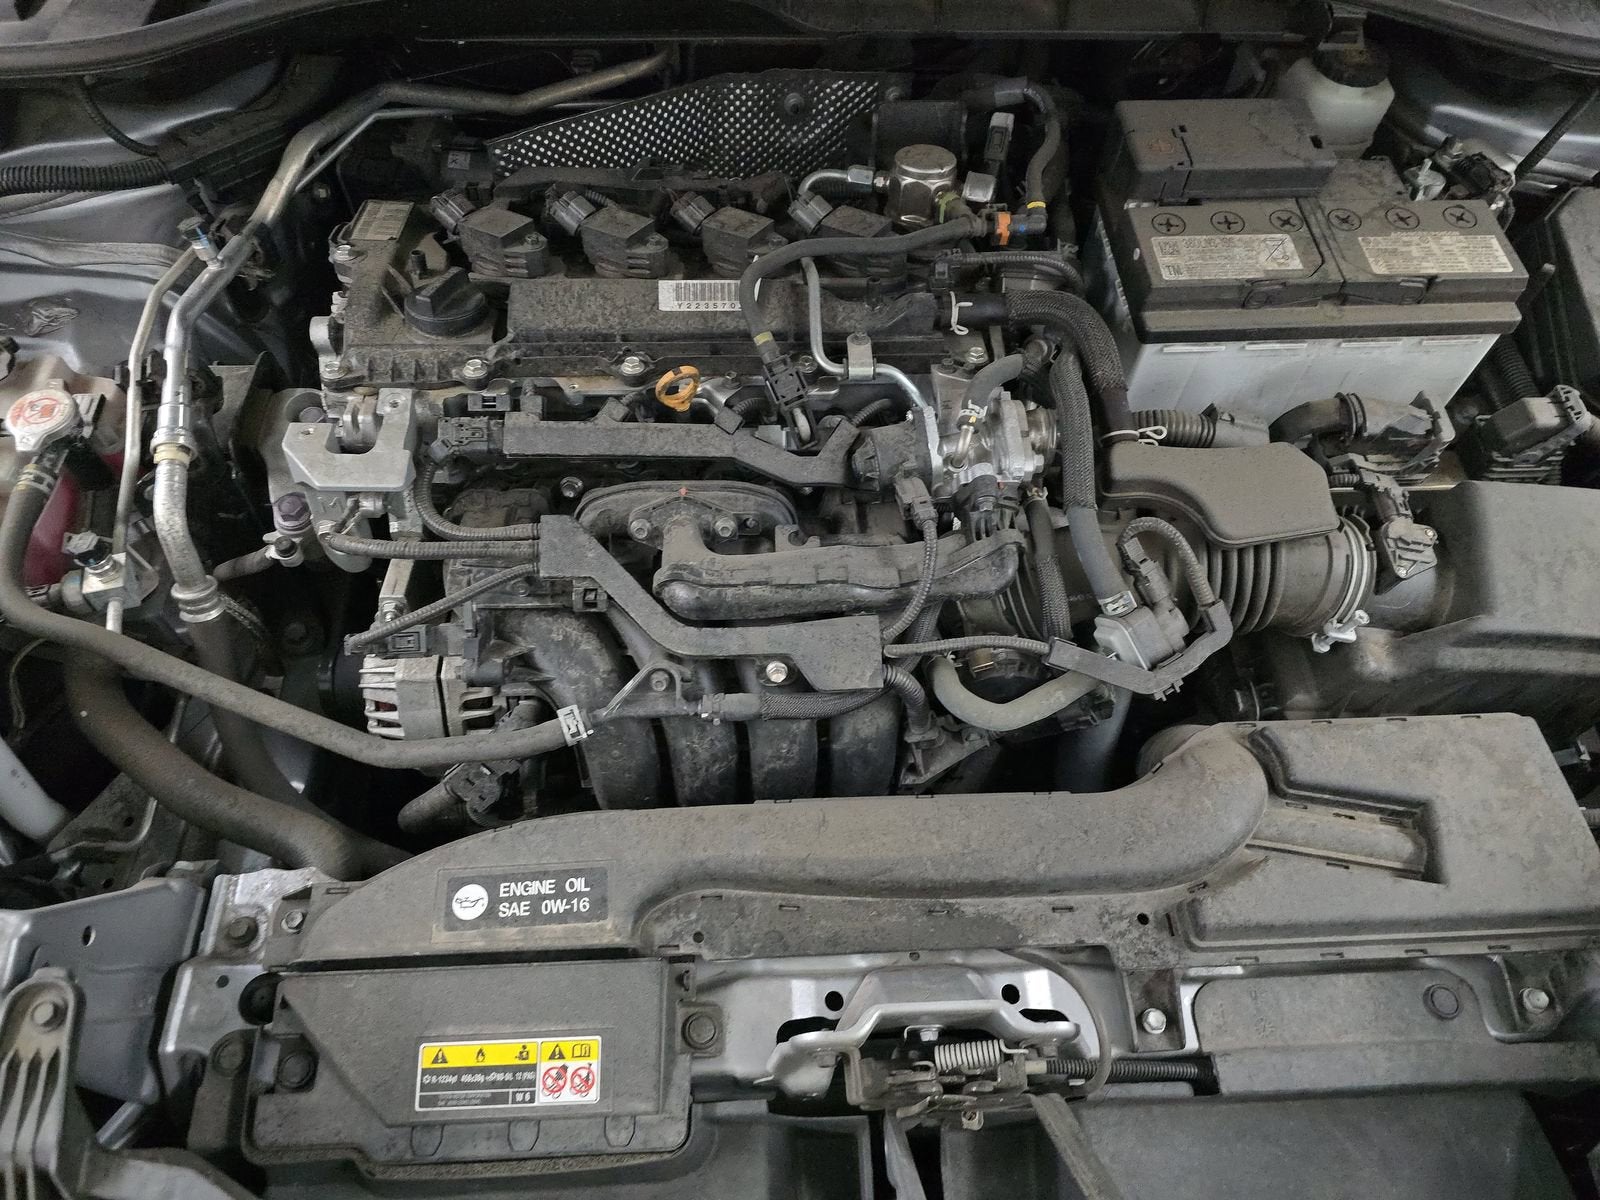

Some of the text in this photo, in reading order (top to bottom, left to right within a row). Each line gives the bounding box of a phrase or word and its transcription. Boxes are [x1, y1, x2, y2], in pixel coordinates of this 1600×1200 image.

[499, 877, 591, 897] ENGINE OIL
[498, 897, 590, 918] SAE 0W-16
